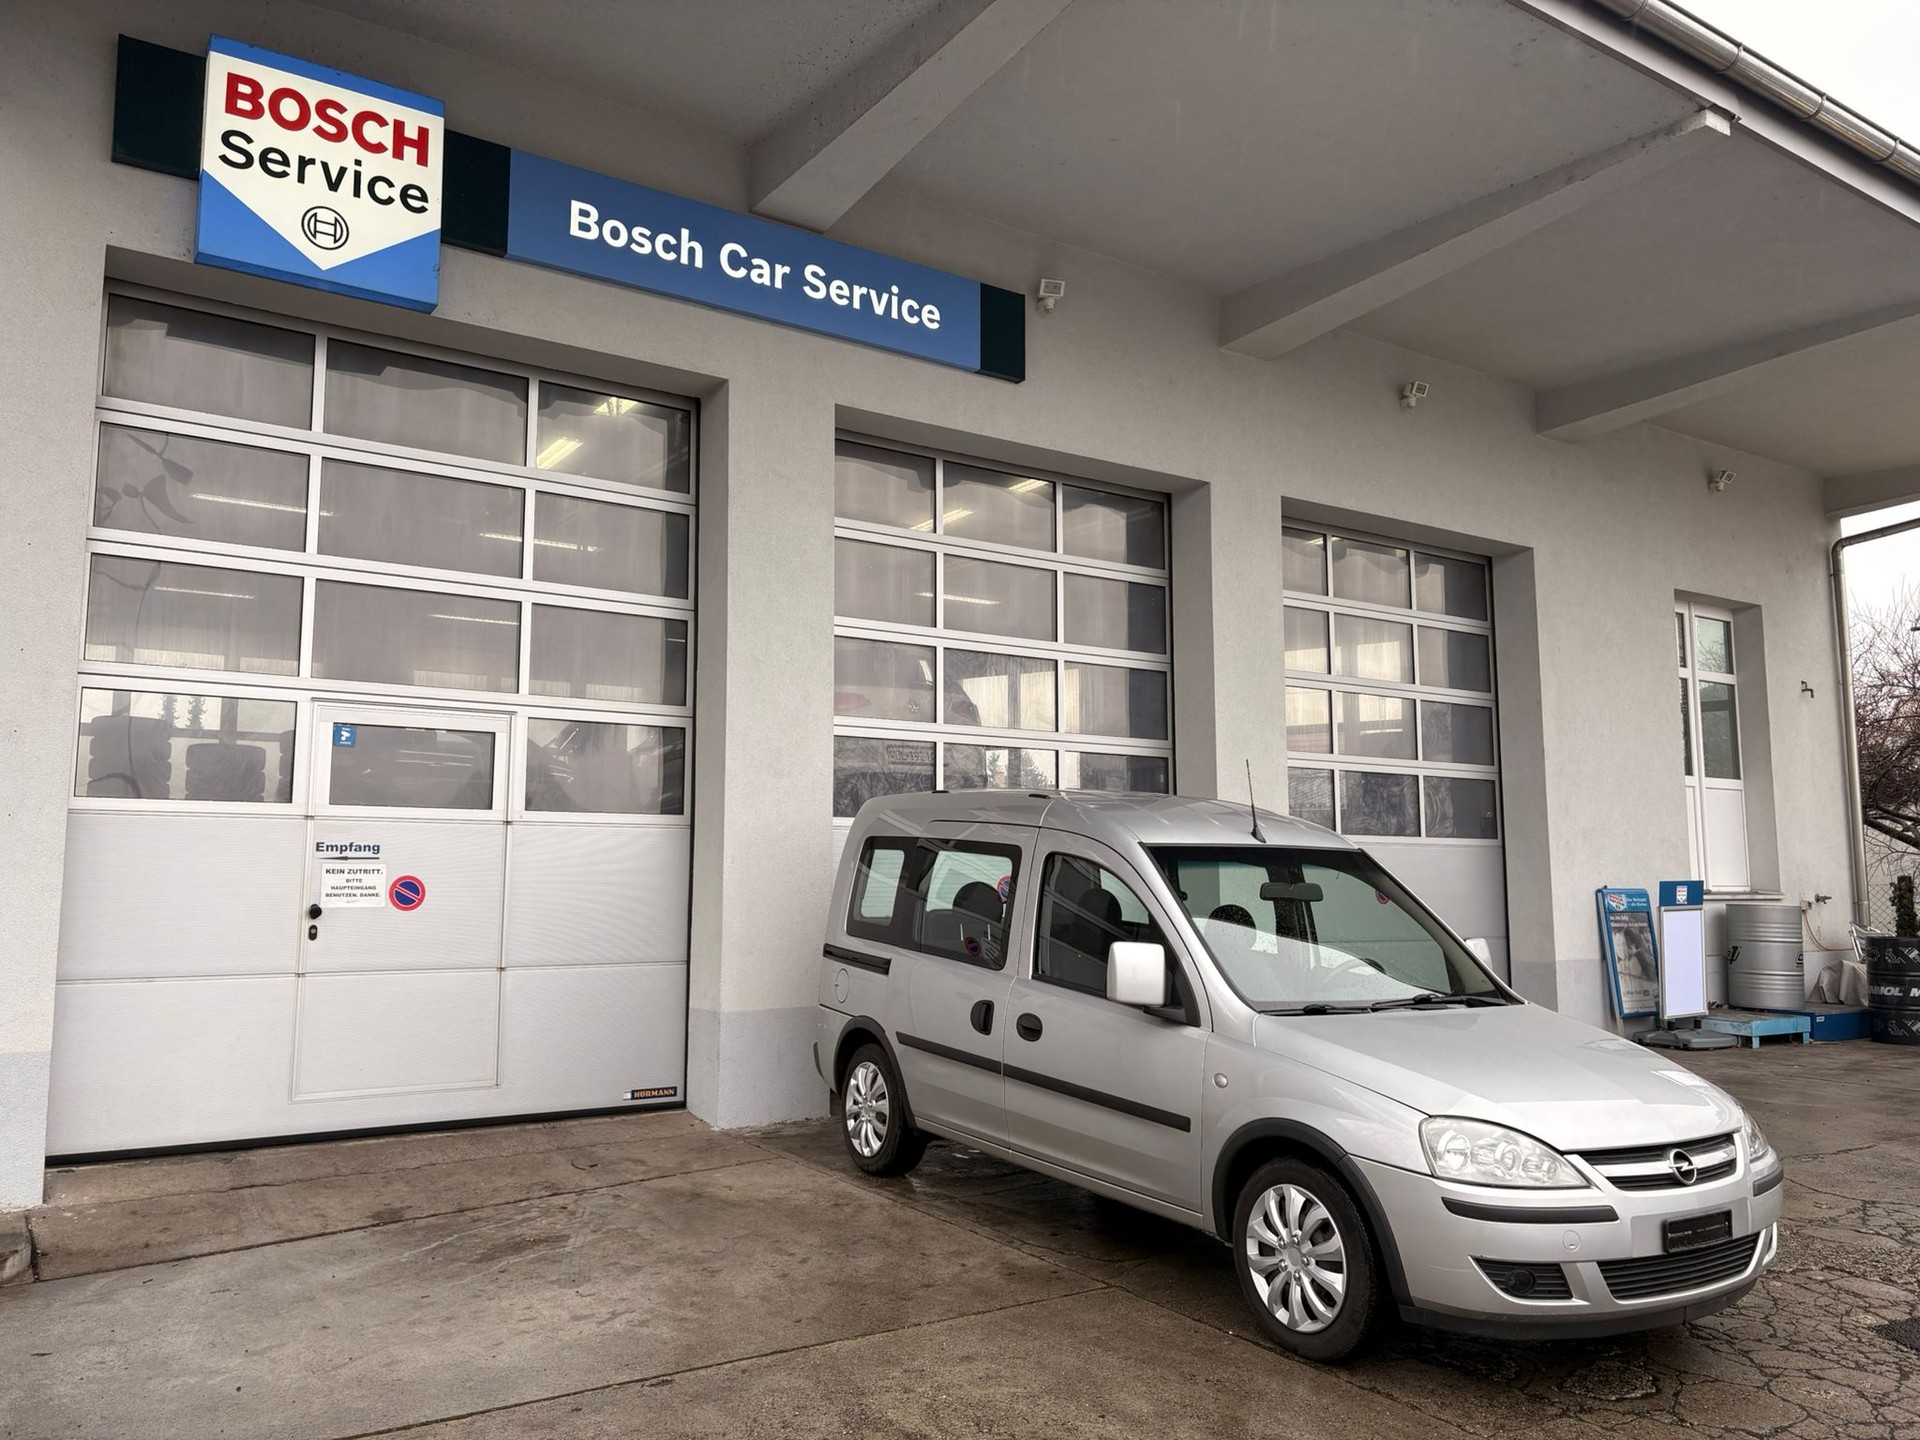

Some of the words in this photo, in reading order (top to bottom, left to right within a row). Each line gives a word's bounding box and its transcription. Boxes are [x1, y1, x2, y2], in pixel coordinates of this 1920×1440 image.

[225, 72, 429, 167] BOSCH
[218, 129, 429, 214] Service
[569, 199, 703, 269] Bosch
[719, 242, 791, 290] Car
[803, 264, 941, 330] Service
[315, 841, 381, 855] Empfang
